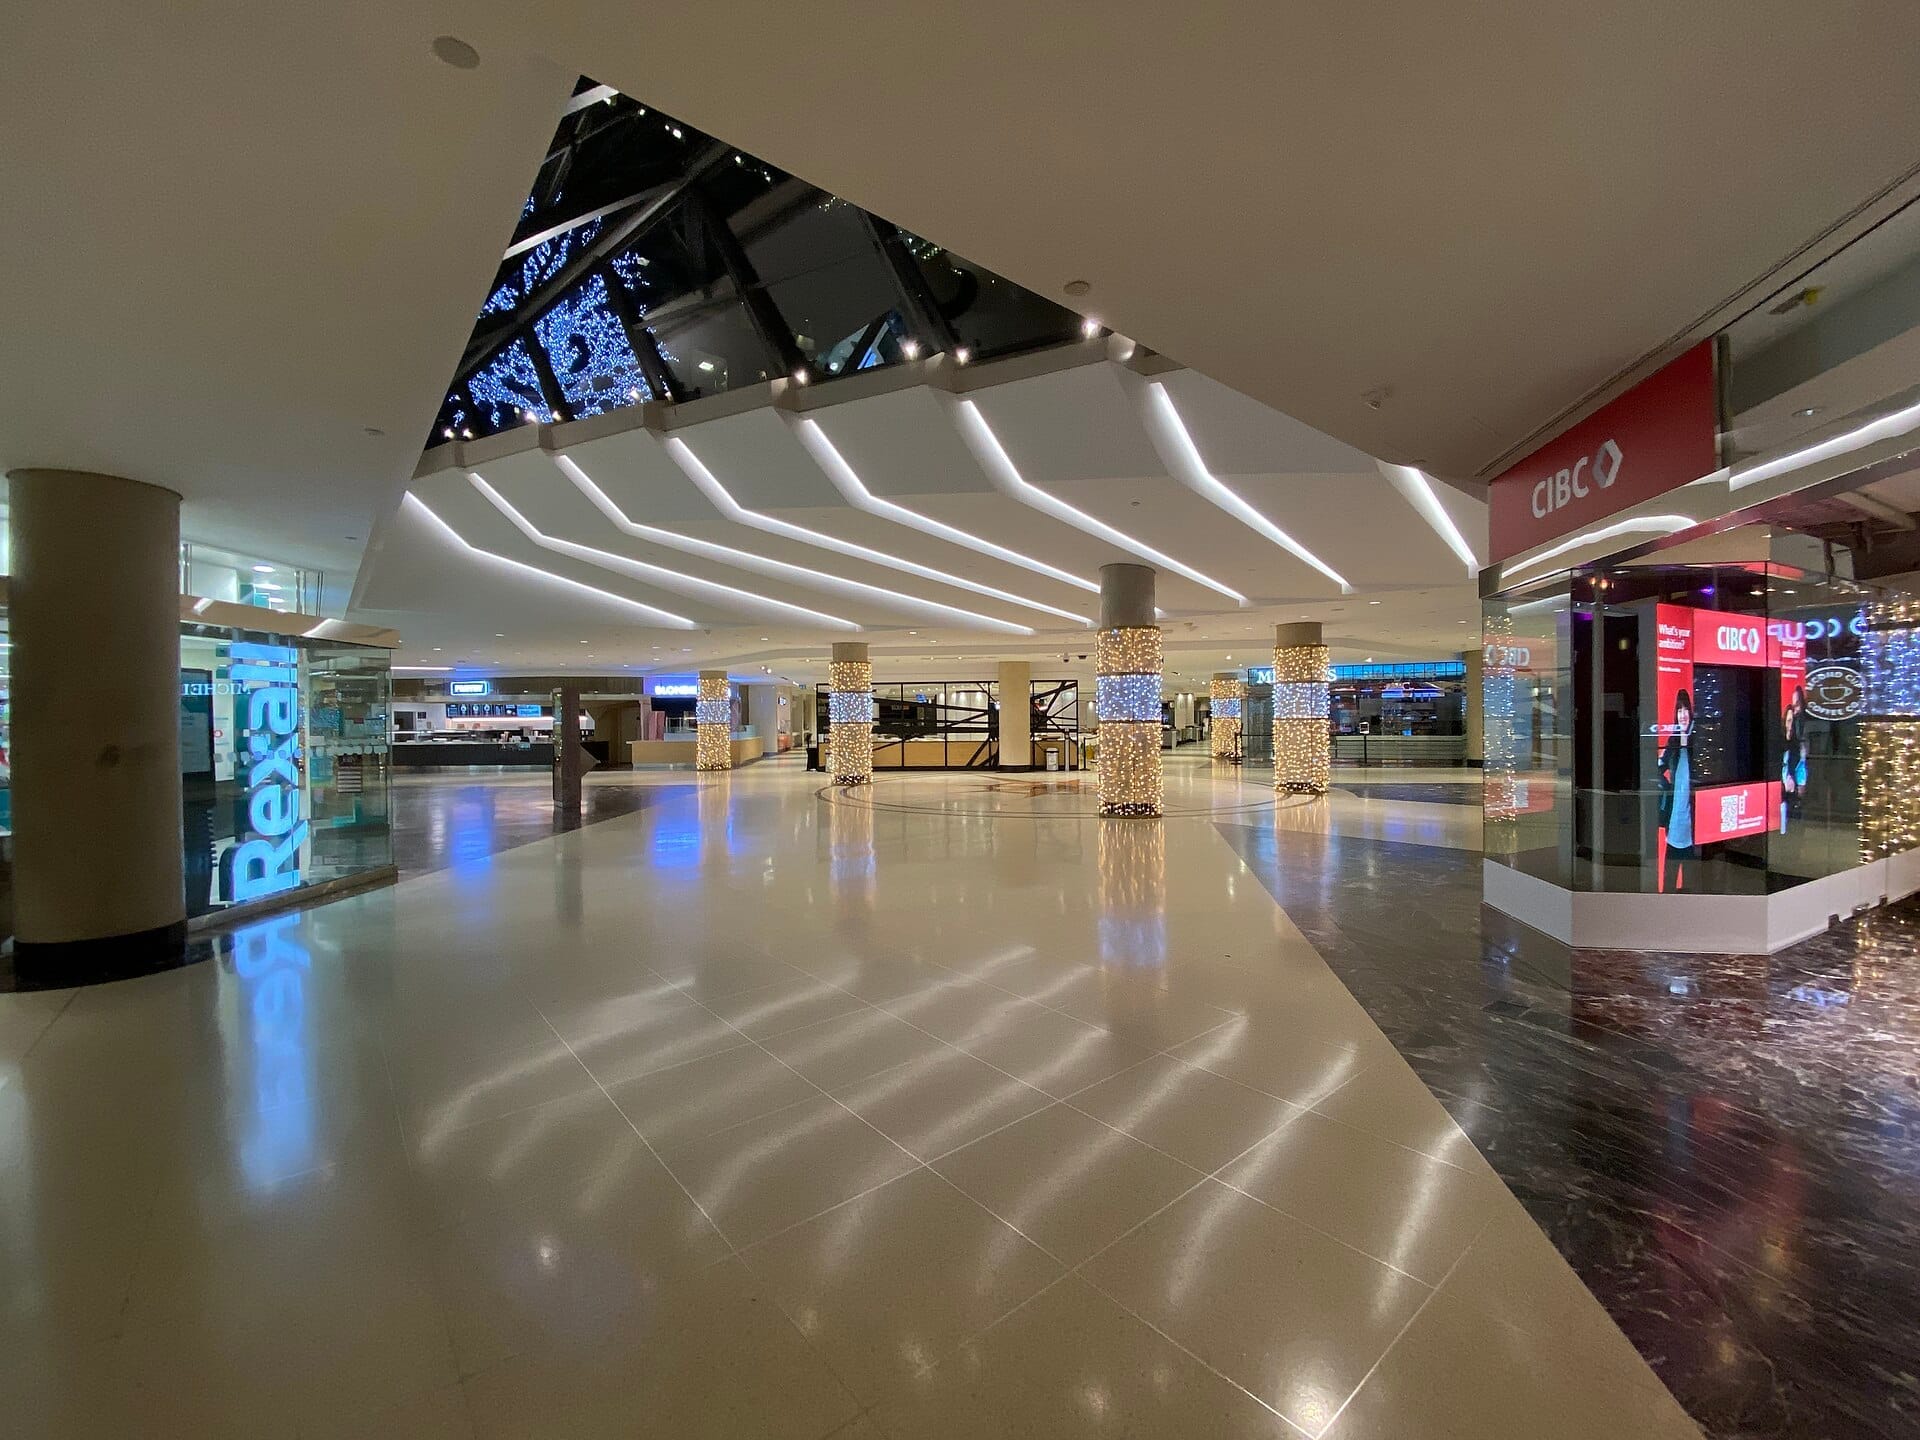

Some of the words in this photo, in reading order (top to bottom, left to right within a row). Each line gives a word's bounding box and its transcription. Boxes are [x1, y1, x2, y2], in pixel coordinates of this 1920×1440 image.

[1532, 456, 1590, 519] CIBC
[1717, 625, 1747, 652] CIBC
[1805, 671, 1843, 690] ECOND
[227, 642, 308, 904] Rexall
